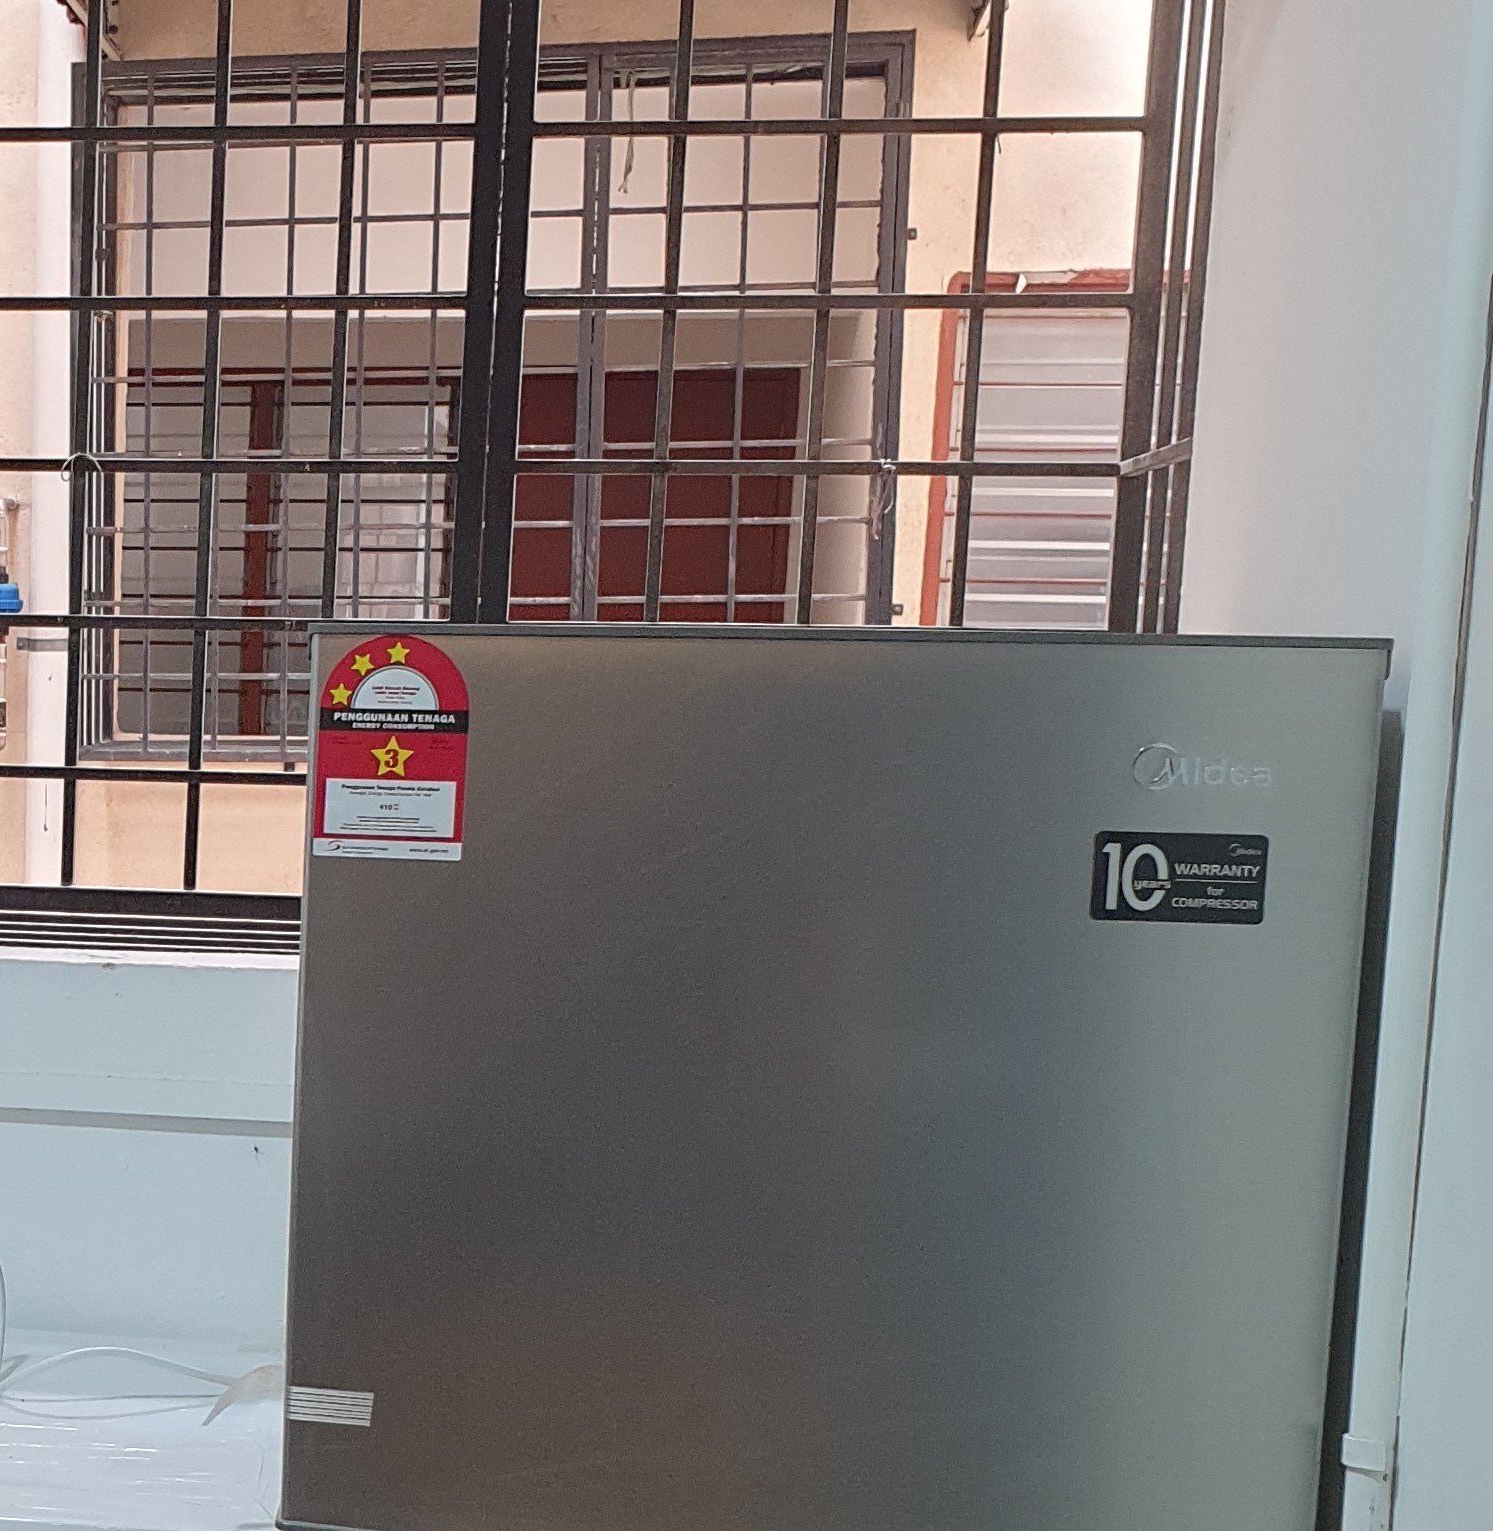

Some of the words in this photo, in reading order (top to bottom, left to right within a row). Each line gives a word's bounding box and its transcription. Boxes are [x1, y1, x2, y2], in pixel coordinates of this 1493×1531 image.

[333, 711, 409, 723] PENGGUNAAN
[412, 714, 456, 724] TENAGA
[384, 749, 399, 769] 3
[1102, 842, 1170, 912] 10
[1174, 863, 1261, 878] WARRANTY
[1133, 880, 1172, 890] years
[1206, 886, 1225, 896] for
[1171, 897, 1258, 910] COMPRESSOR
